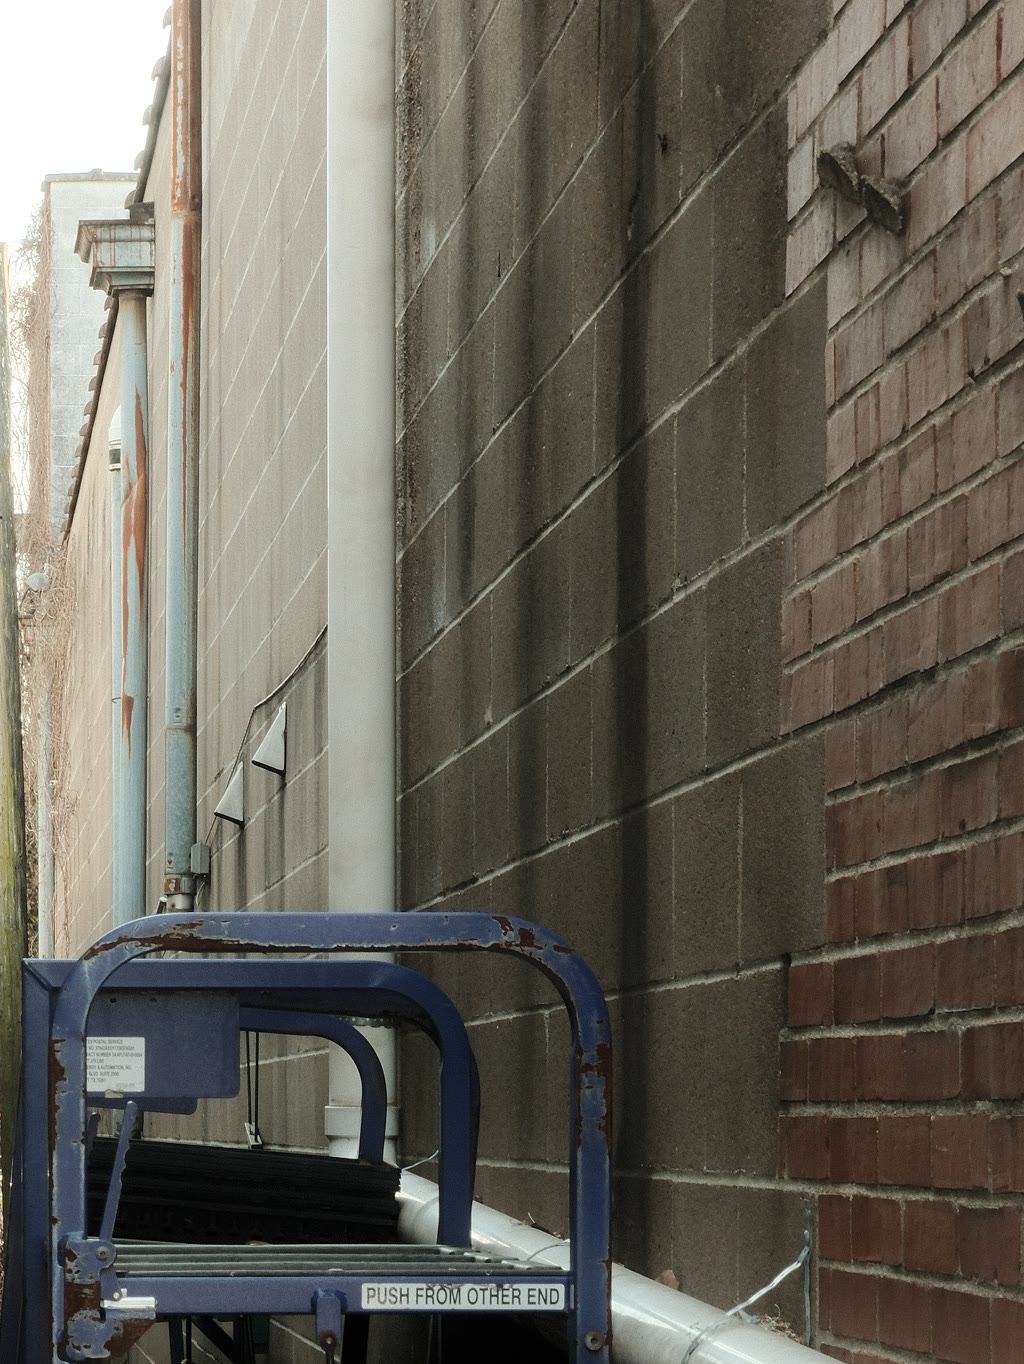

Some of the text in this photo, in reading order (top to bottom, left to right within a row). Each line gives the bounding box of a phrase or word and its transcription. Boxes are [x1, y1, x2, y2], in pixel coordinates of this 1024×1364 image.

[366, 1287, 560, 1305] PUSH FROM OTHER END
